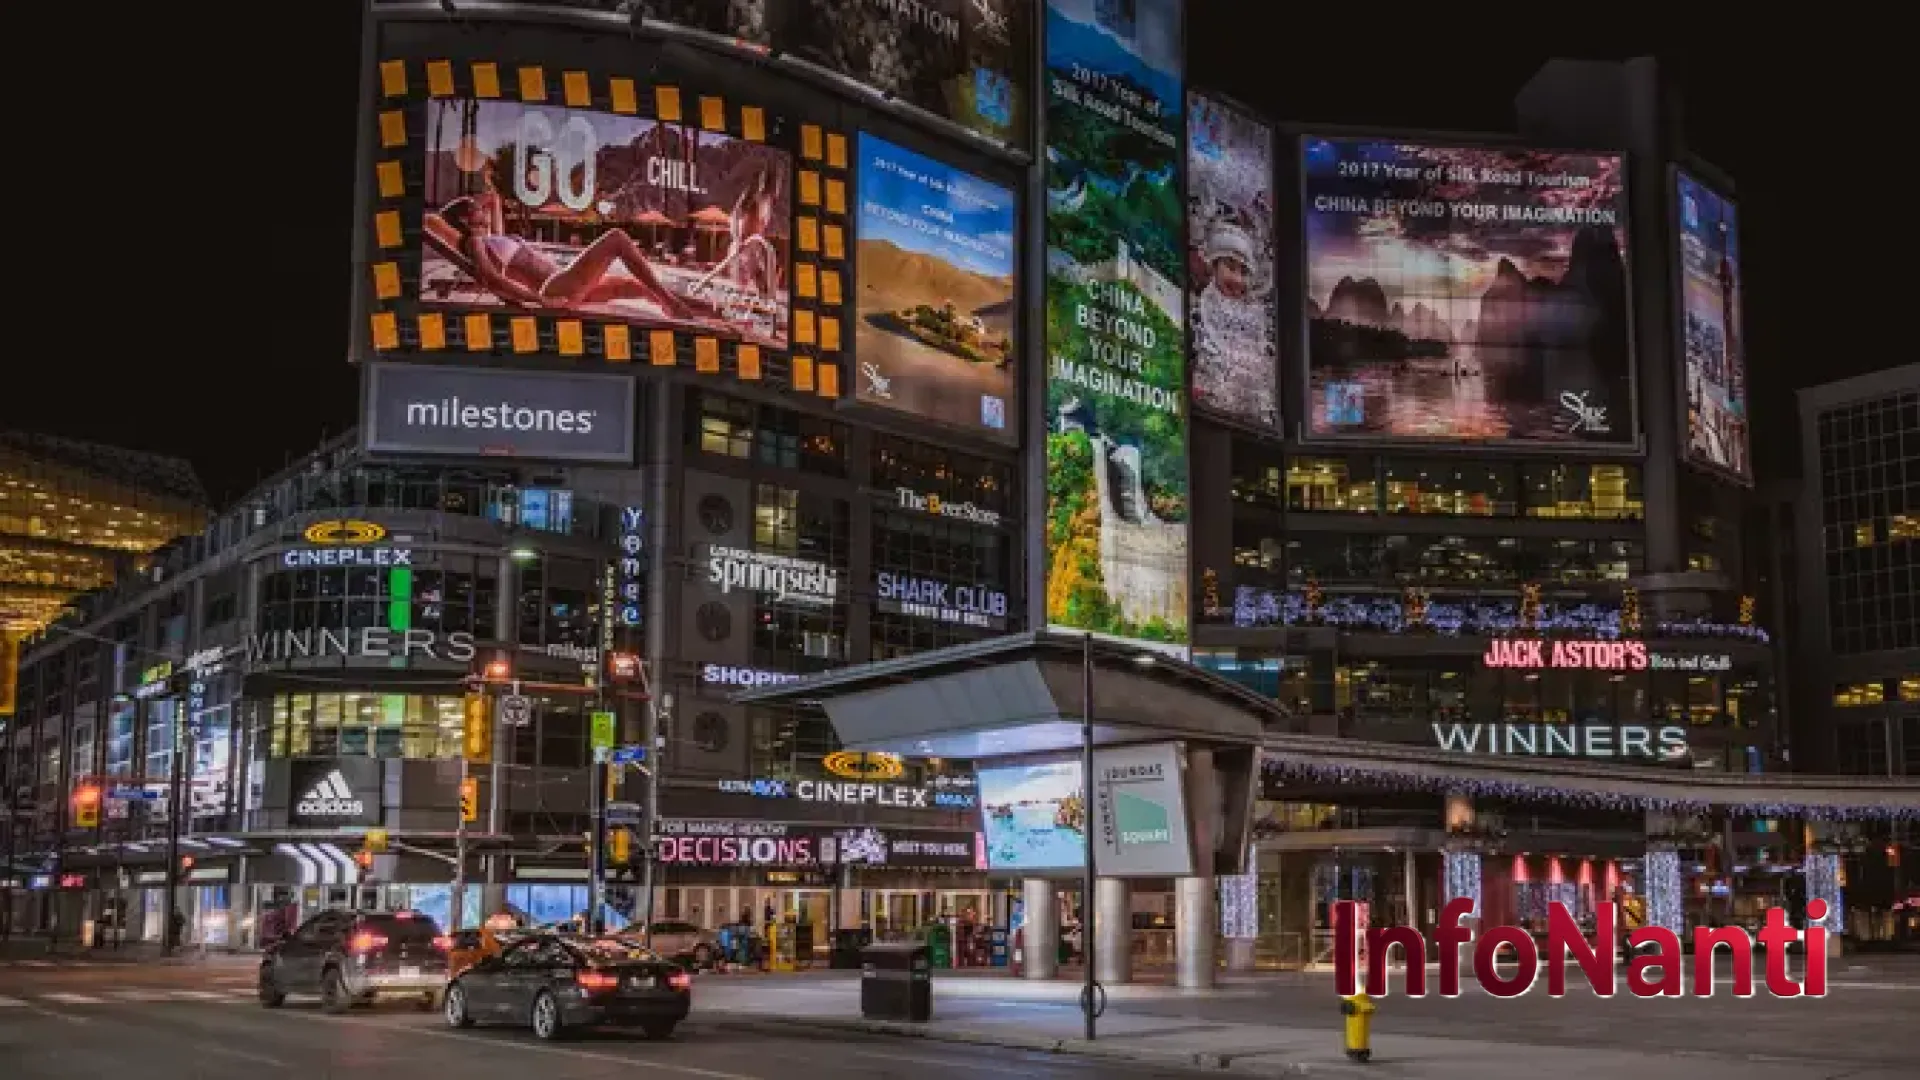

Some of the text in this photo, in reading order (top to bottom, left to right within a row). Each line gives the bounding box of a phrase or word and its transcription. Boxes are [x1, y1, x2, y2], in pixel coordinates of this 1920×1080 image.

[1071, 62, 1108, 91] 2017
[1110, 79, 1142, 107] Year
[1337, 161, 1380, 178] 2017
[1383, 162, 1421, 179] Year
[1424, 164, 1444, 180] of
[1480, 168, 1522, 184] Road
[1527, 170, 1591, 189] Tourism
[1314, 195, 1617, 225] CHINA BEYOND YOUR IMAGINATION
[1086, 278, 1146, 316] CHINA
[1076, 303, 1157, 349] BEYOND
[1089, 335, 1142, 374] YOUR
[1050, 354, 1178, 414] IMAGINATION
[406, 395, 594, 435] milestones
[284, 548, 412, 567] CINEPLEX
[878, 572, 1007, 617] SHARK CLUB
[244, 626, 476, 662] WINNERS
[1484, 638, 1544, 668] JACK
[1551, 639, 1648, 670] ASTOR'S
[1432, 723, 1690, 762] WINNERS
[797, 780, 927, 808] CINEPLEX
[660, 820, 686, 834] FOR
[687, 820, 734, 836] MAKING
